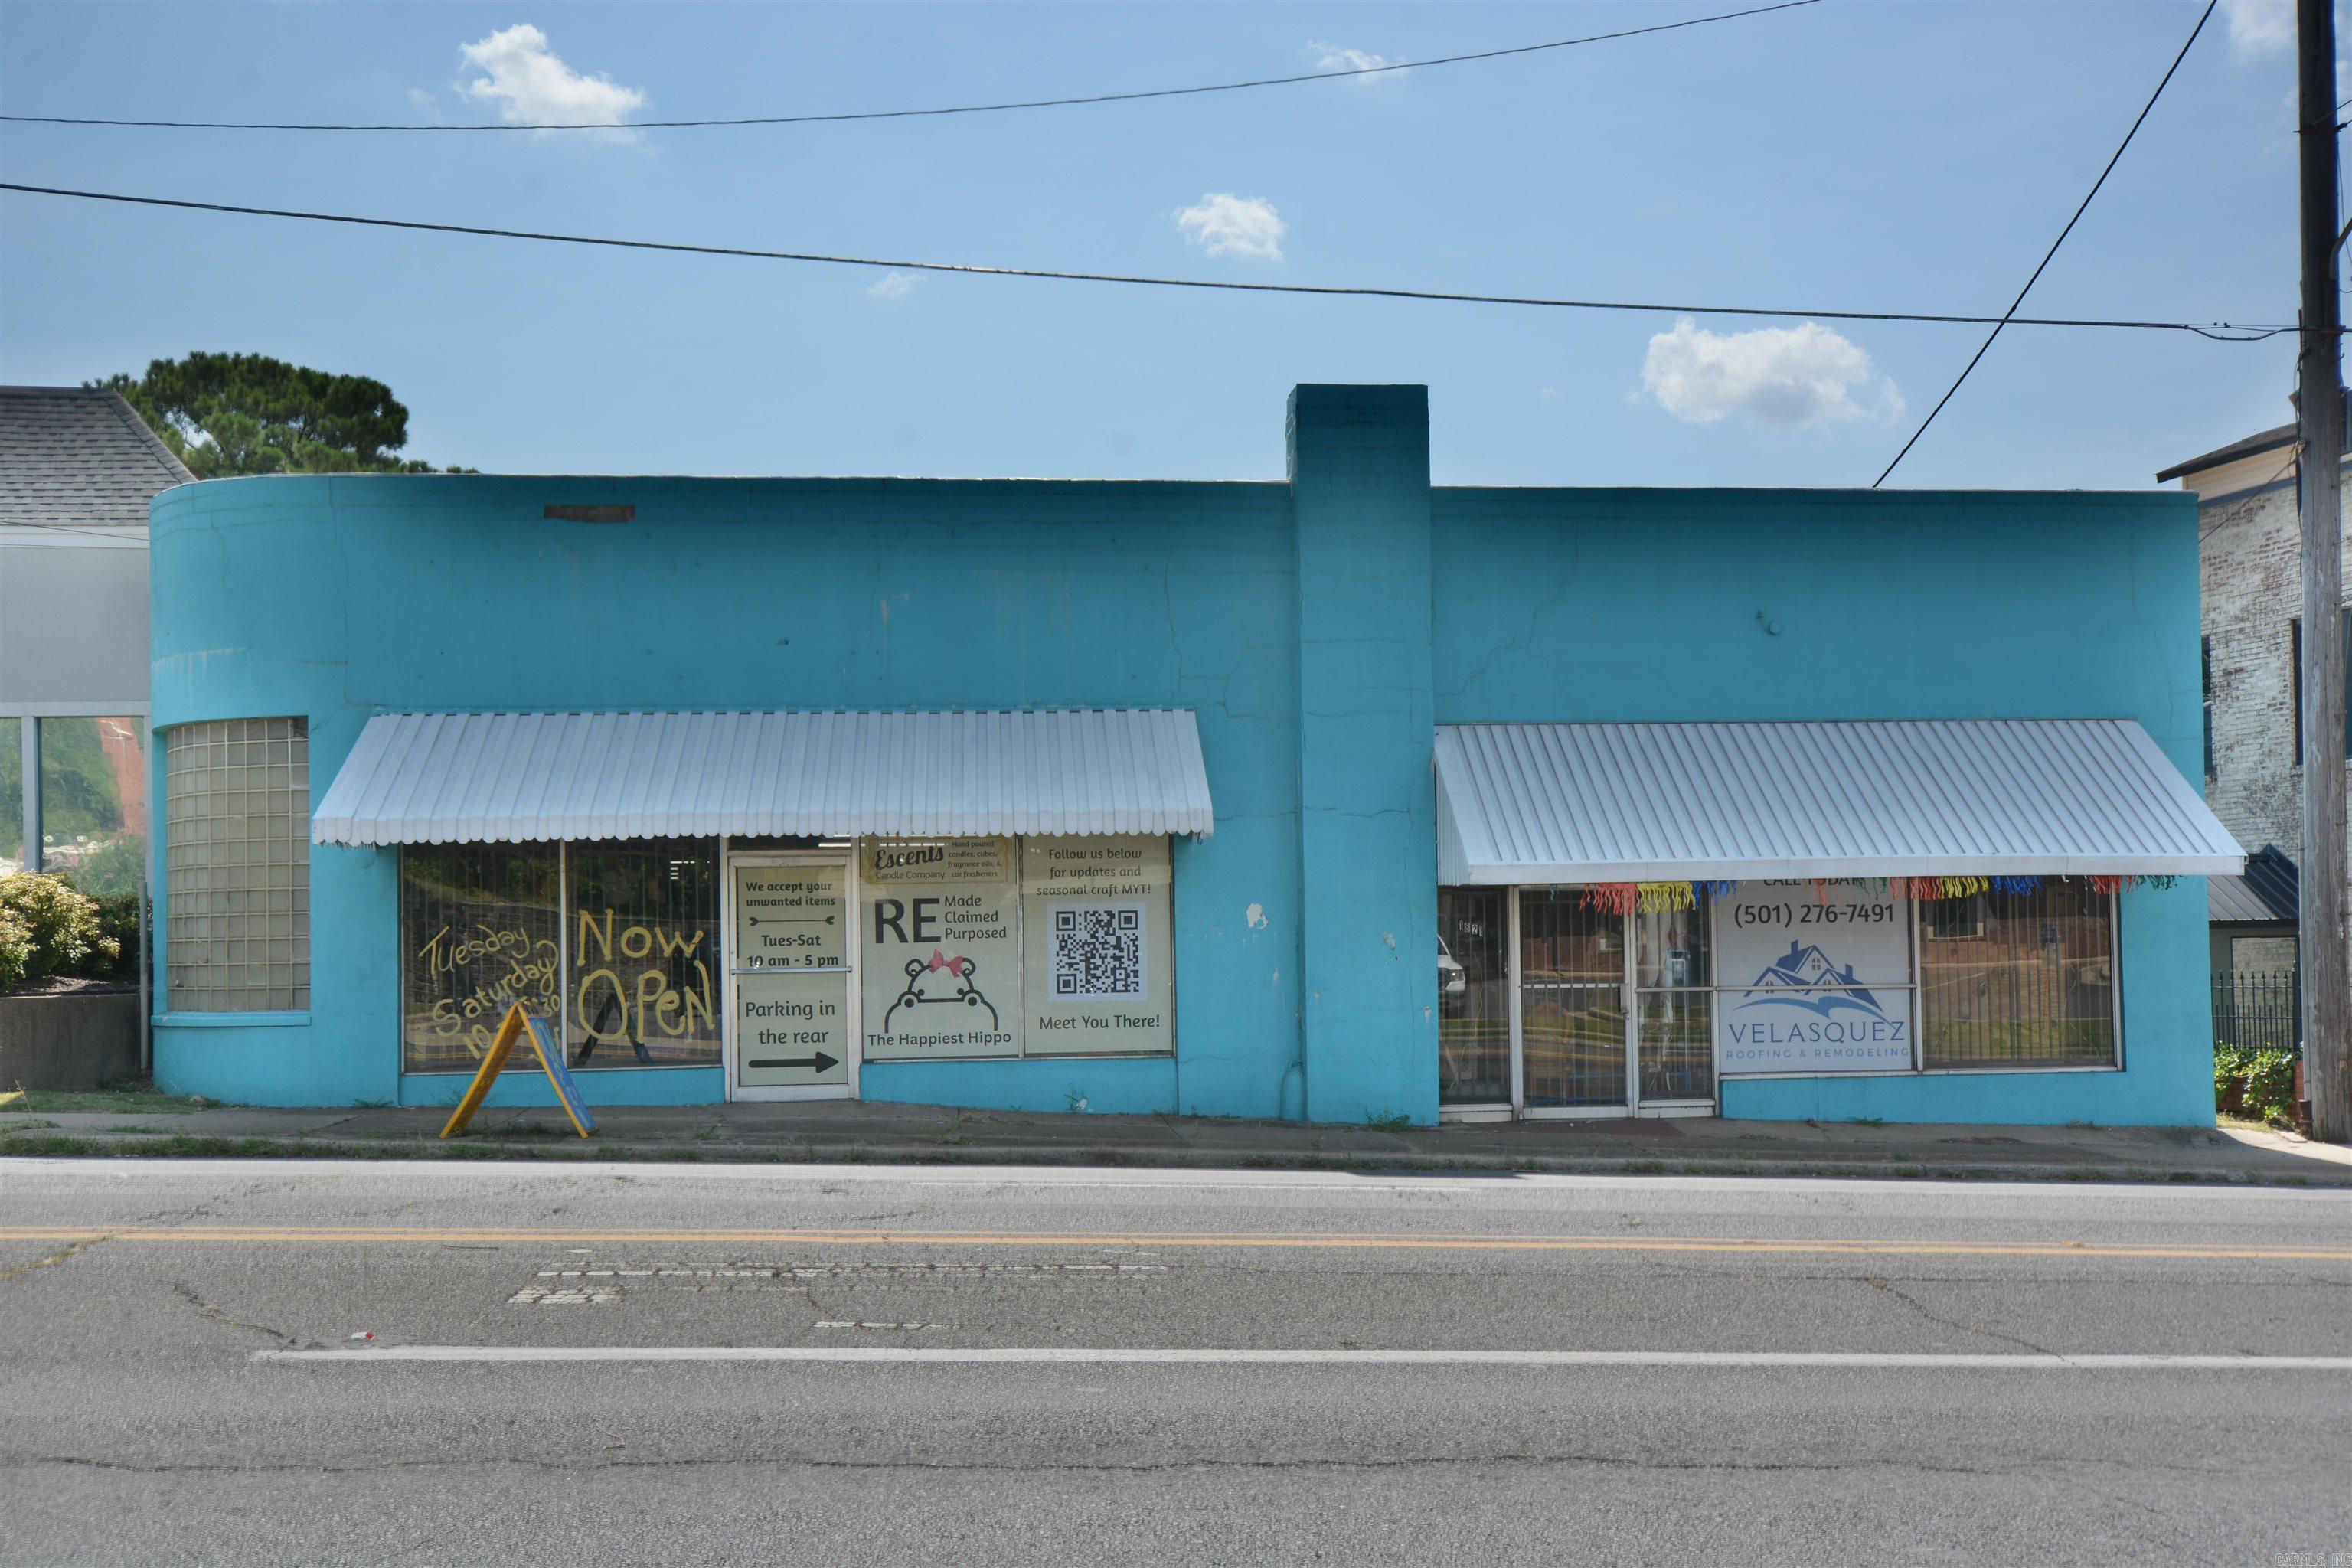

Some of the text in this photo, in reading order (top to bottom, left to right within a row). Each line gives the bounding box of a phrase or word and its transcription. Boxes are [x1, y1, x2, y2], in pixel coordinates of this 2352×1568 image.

[874, 845, 944, 871] Escents
[1049, 848, 1142, 860] Follow us below
[948, 861, 980, 869] fragrance
[876, 871, 946, 880] Candle Company
[963, 871, 998, 879] fresheners
[1050, 866, 1141, 880] for updates and
[746, 882, 832, 894] We accept your
[1037, 884, 1152, 897] seasonal craft MYT!
[746, 896, 836, 907] unwanted items
[945, 894, 982, 907] Made
[874, 897, 942, 944] RE
[945, 910, 999, 923] Claimed
[1734, 903, 1894, 929] (501) 276-7491
[761, 934, 822, 947] Tues-Sat
[945, 926, 1008, 942] Purposed
[418, 925, 531, 980] Tuesday
[747, 955, 763, 968] 10
[768, 957, 789, 966] am
[805, 955, 813, 966] 5
[818, 956, 839, 968] pm
[432, 939, 559, 1037] Saturday
[745, 1000, 835, 1020] Parking in
[1040, 1014, 1160, 1030] Meet You There!
[758, 1028, 828, 1044] the rear
[867, 1031, 1011, 1047] The Happiest Hippo
[1728, 1021, 1905, 1044] VELASQUEZ
[1726, 1047, 1909, 1060] ROOFING & REMODELING
